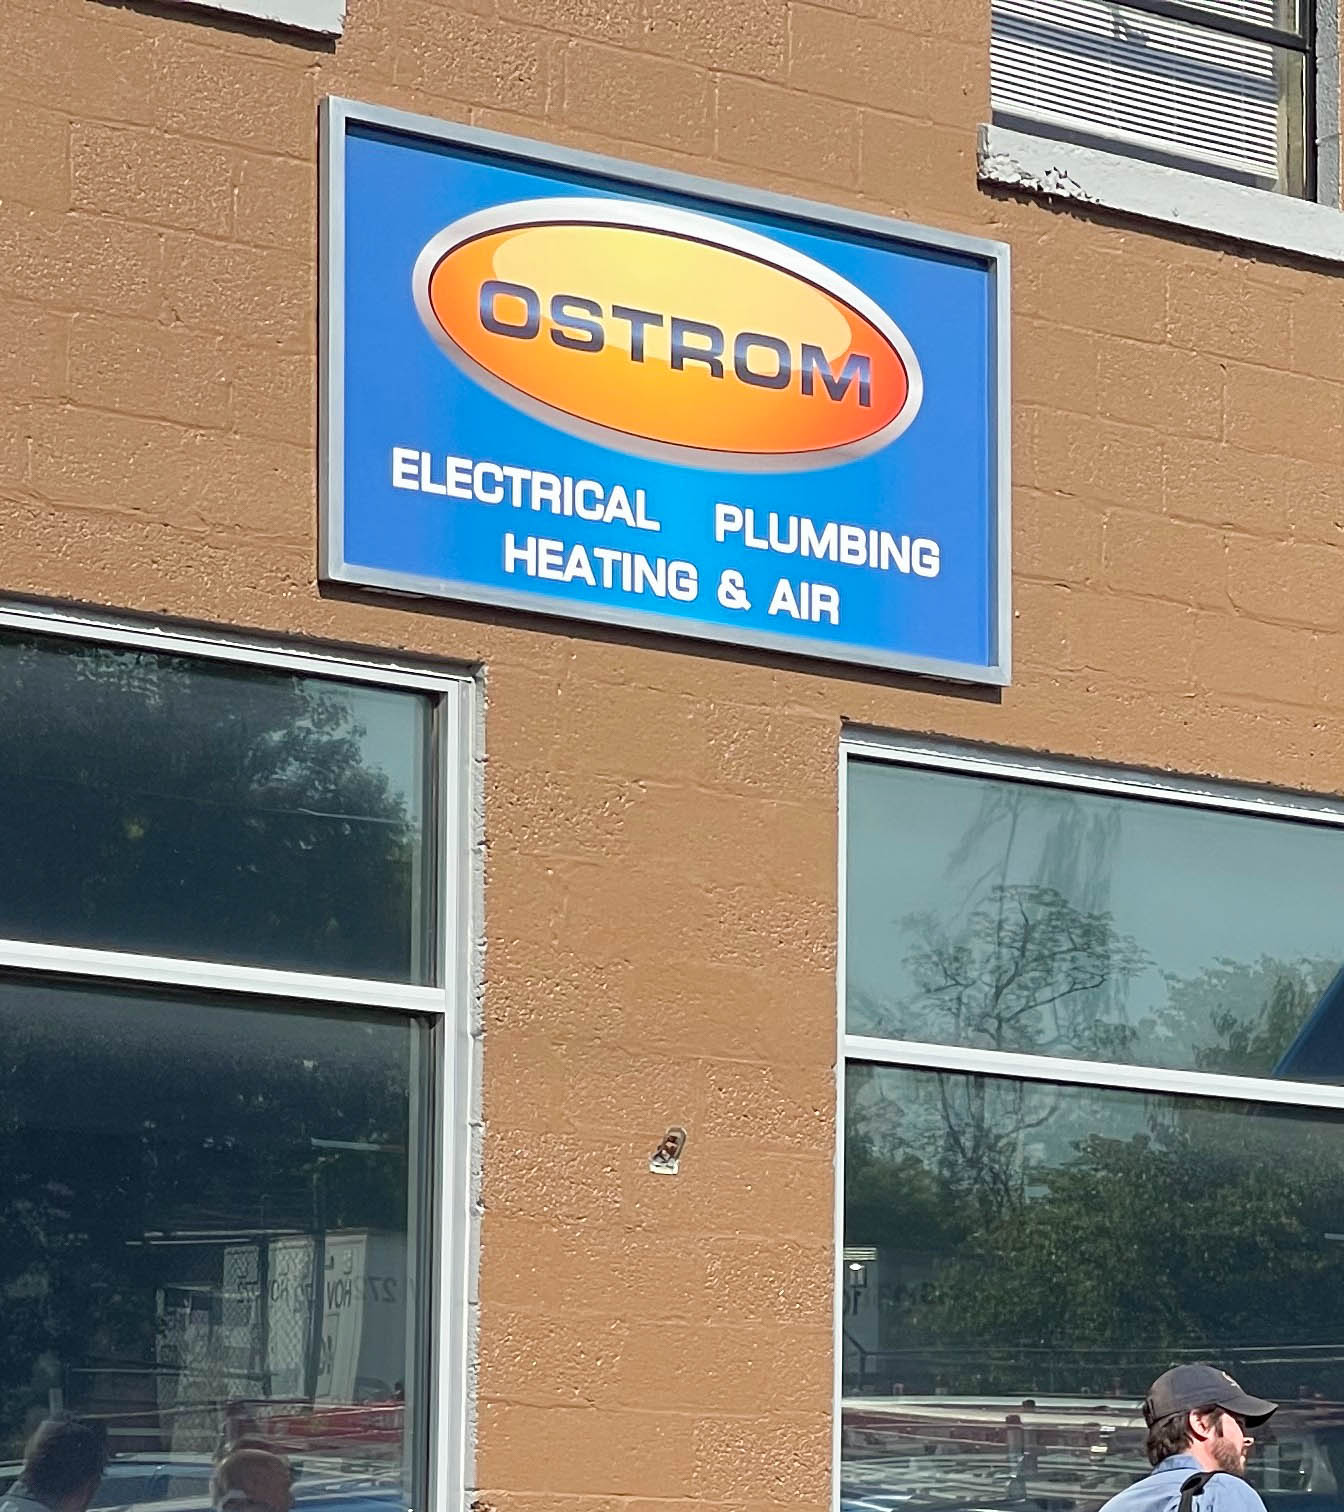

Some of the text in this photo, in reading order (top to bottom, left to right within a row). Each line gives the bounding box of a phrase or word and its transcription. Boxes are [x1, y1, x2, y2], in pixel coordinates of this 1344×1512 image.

[480, 279, 871, 408] OSTROM
[391, 446, 941, 577] ELECTRICAL PLUMBING
[503, 533, 841, 625] HEATING & AIR
